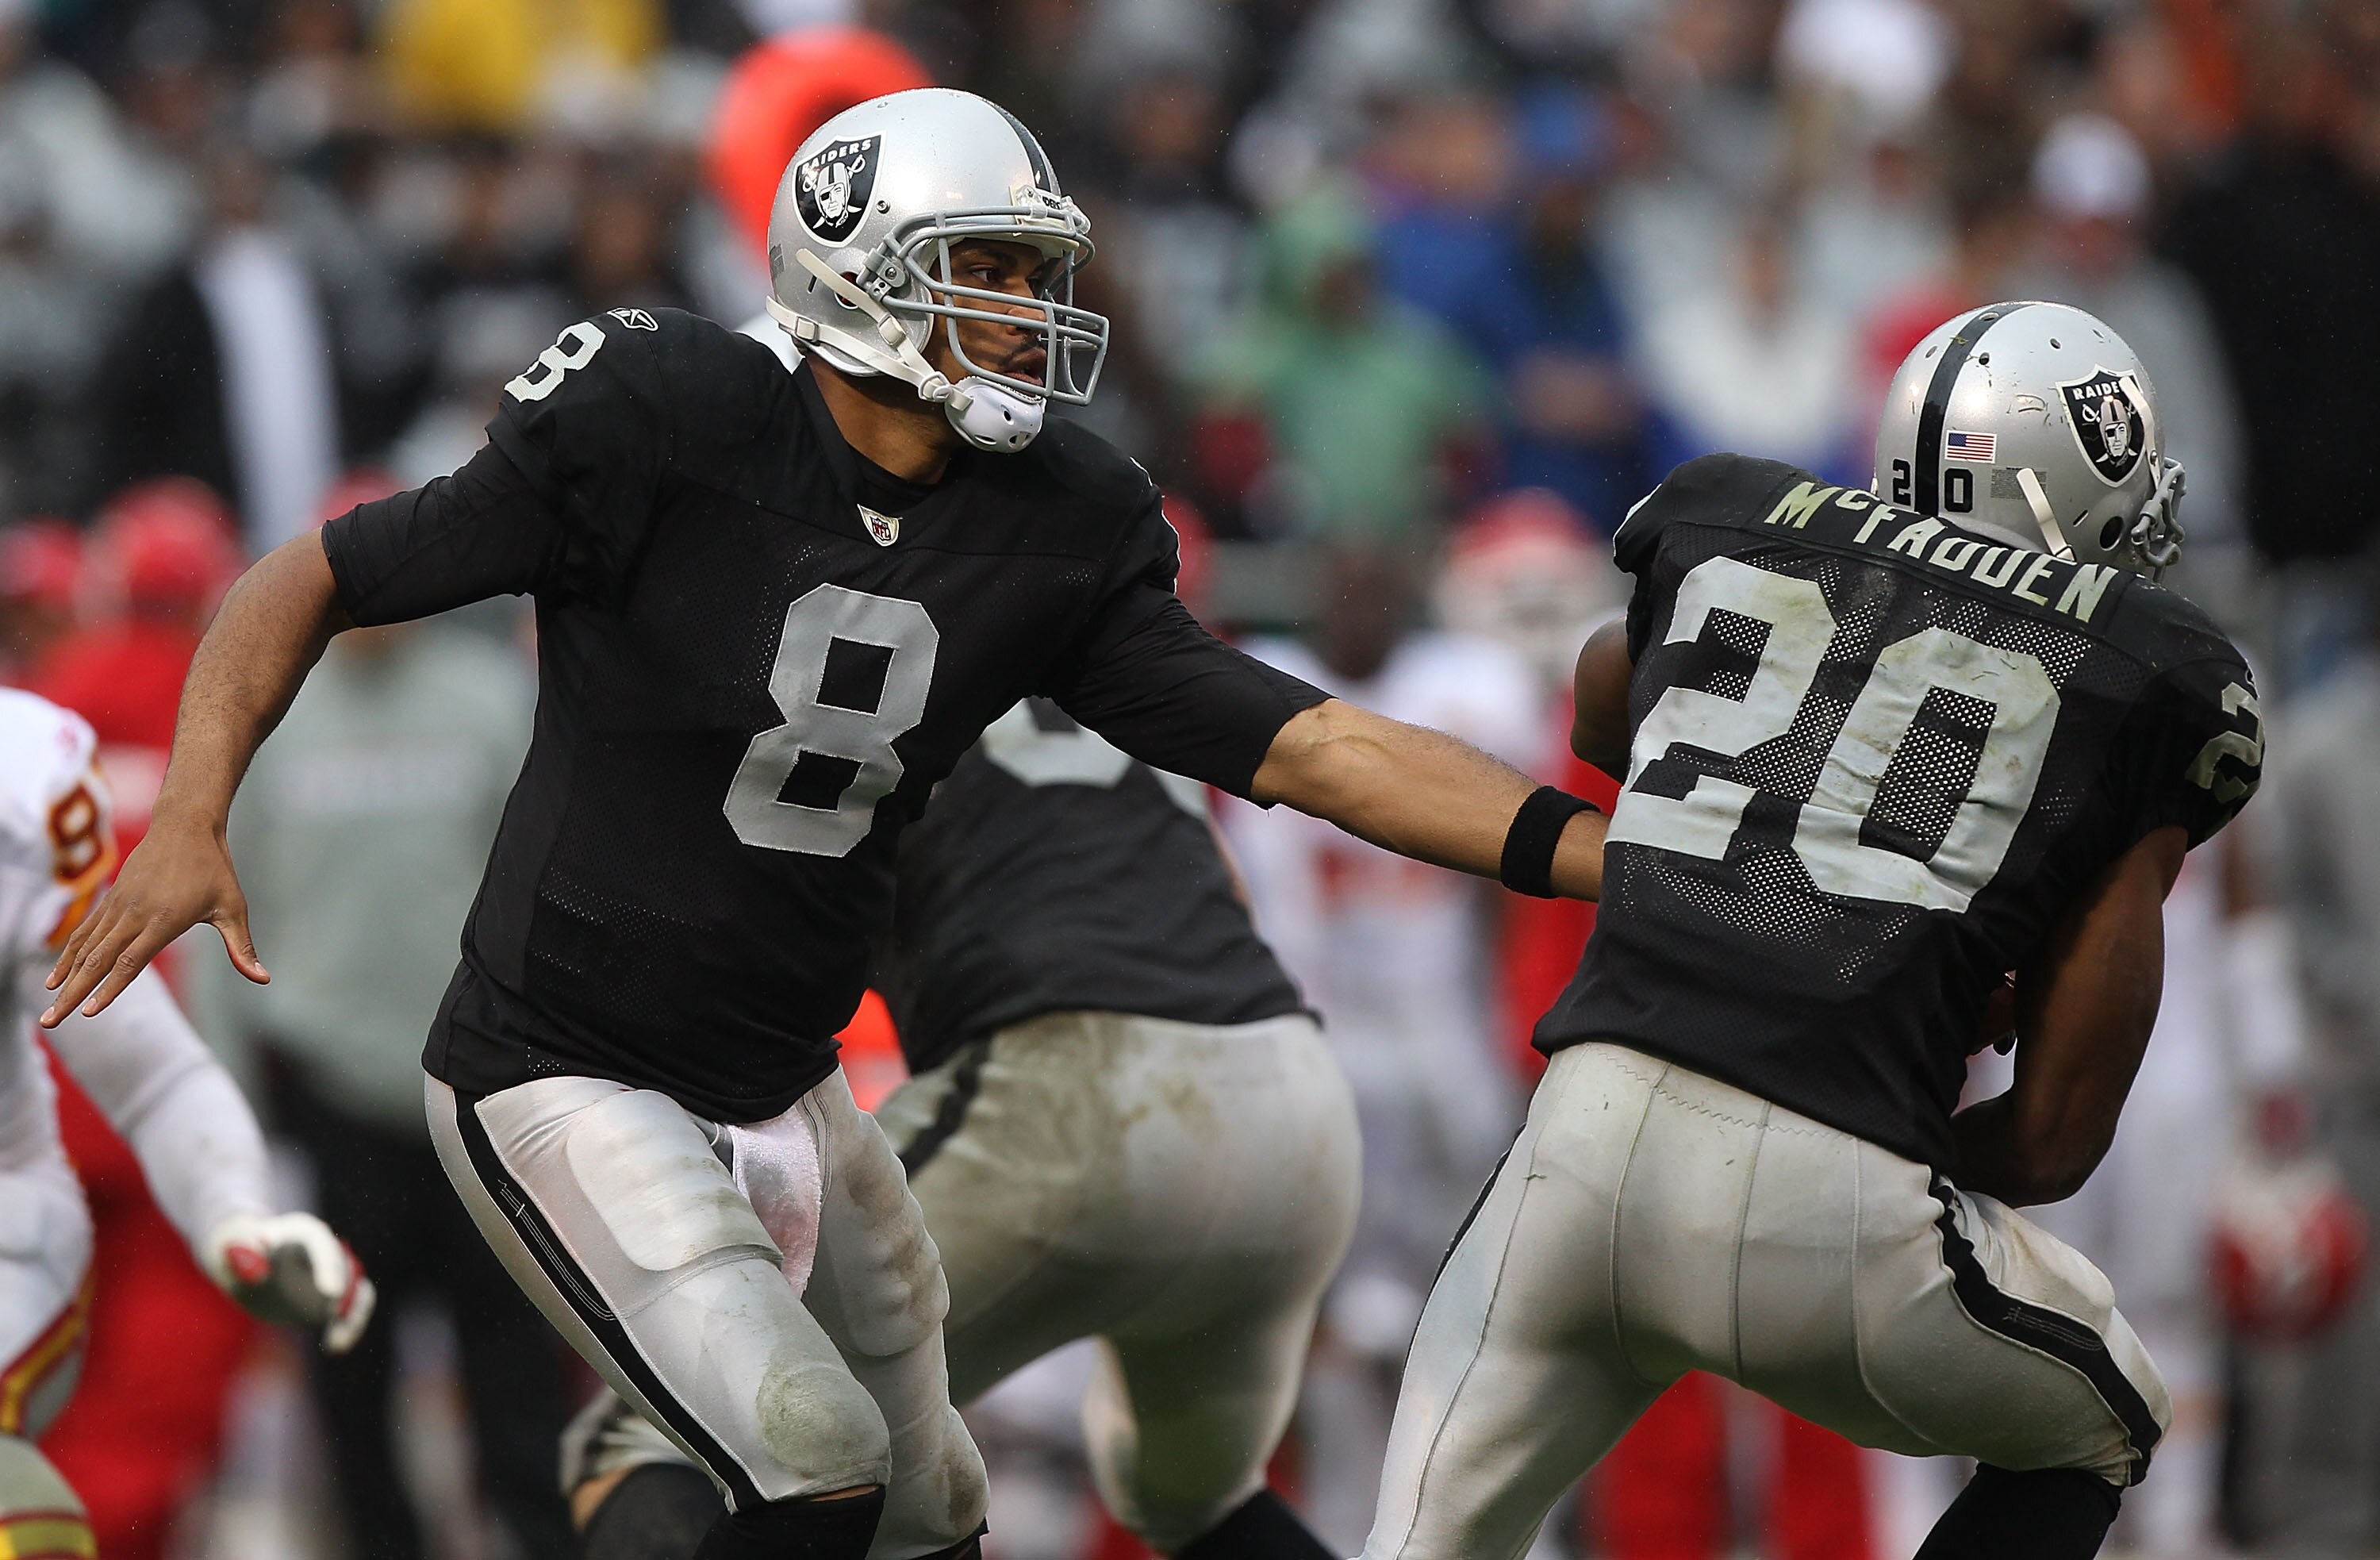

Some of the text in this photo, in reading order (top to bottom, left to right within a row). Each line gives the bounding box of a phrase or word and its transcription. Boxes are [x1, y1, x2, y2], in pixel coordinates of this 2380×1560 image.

[801, 139, 871, 175] RAIDERS
[505, 321, 606, 403] 8
[2072, 381, 2120, 401] RAIDE
[873, 524, 891, 540] NFL
[723, 582, 940, 858] 8
[1603, 555, 2062, 913] 20
